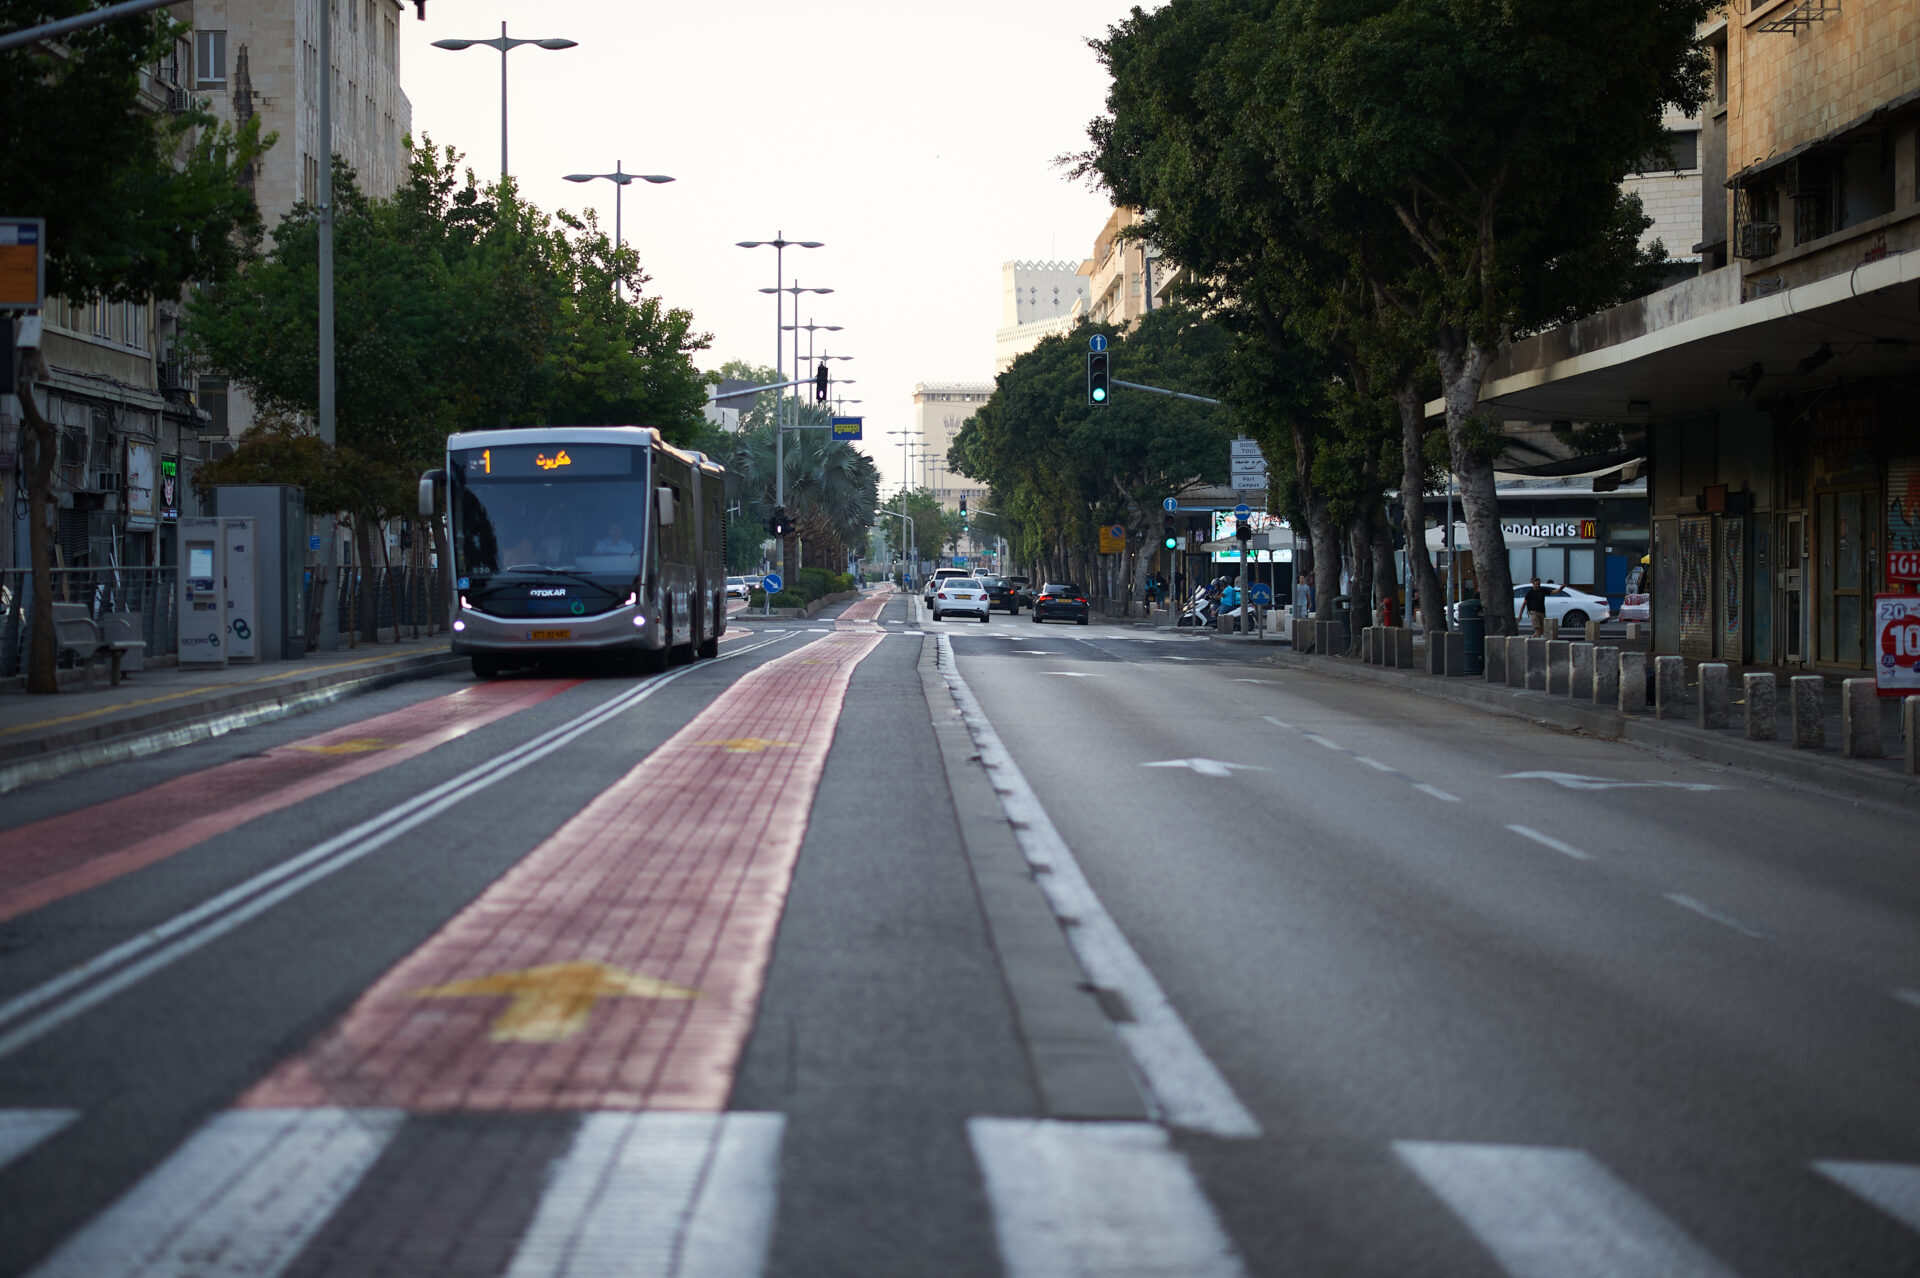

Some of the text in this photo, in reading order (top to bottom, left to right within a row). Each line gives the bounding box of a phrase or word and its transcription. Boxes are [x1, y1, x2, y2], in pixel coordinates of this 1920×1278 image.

[483, 450, 490, 473] 1
[1501, 523, 1576, 537] cDonald's
[530, 588, 566, 597] OTOKAR
